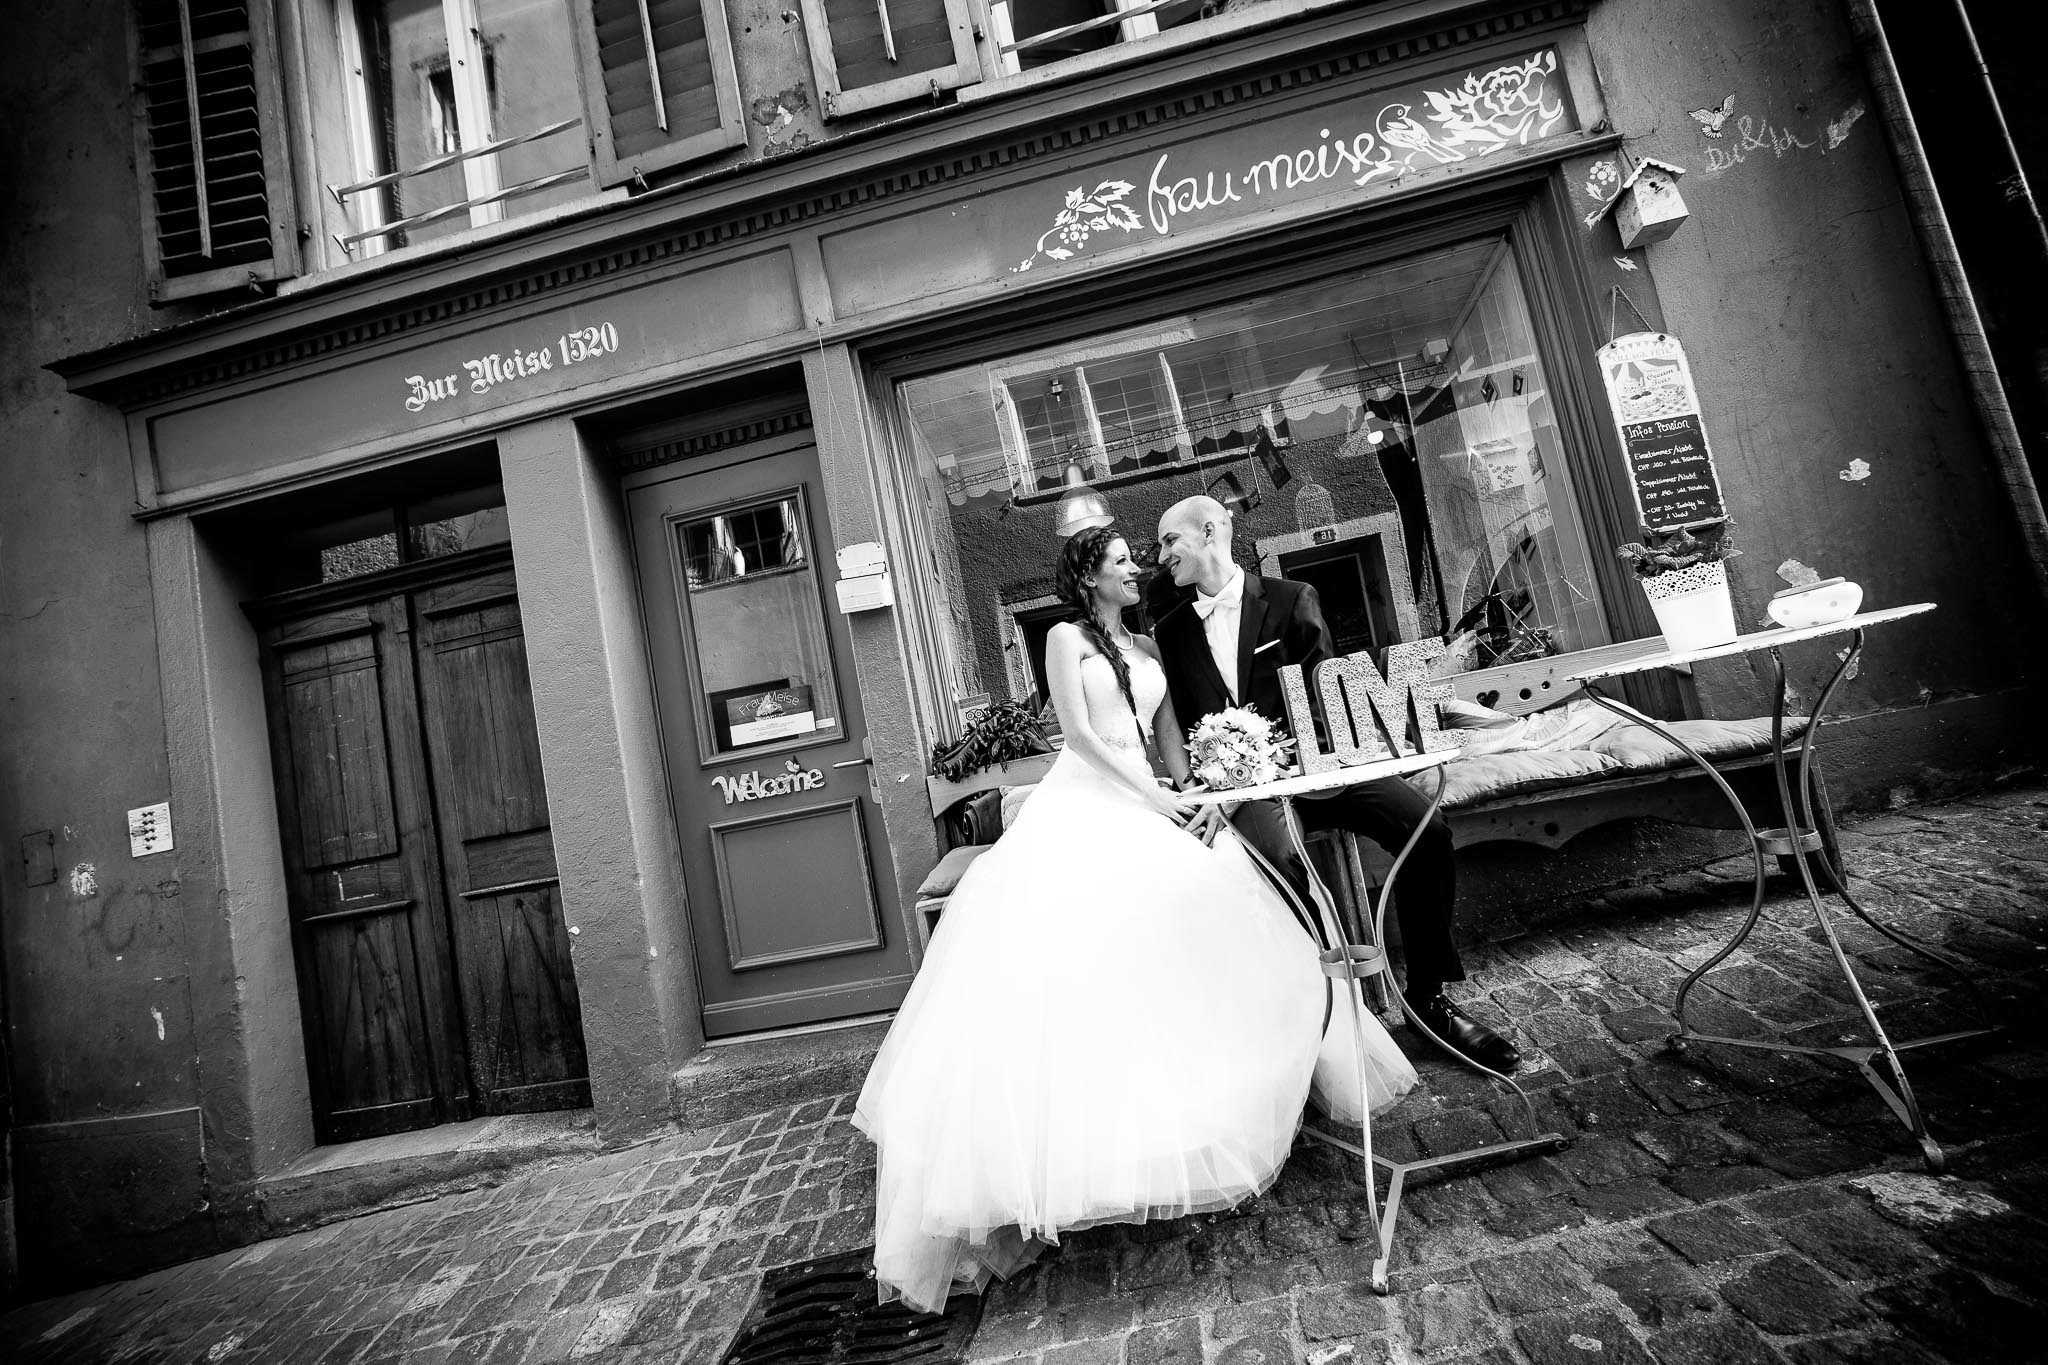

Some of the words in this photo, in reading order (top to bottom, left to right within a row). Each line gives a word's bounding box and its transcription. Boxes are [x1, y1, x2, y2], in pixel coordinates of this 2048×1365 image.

[1146, 153, 1246, 235] frau
[1242, 126, 1386, 194] meise
[404, 374, 459, 412] Zur
[462, 347, 554, 394] Meise
[557, 321, 619, 365] 1520
[1646, 368, 1674, 380] Cream
[1626, 425, 1653, 439] Infos
[1654, 419, 1690, 433] Pension
[738, 697, 765, 717] Frau
[766, 691, 800, 706] Meise
[1277, 636, 1468, 776] LOVE
[711, 767, 825, 805] Welcome
